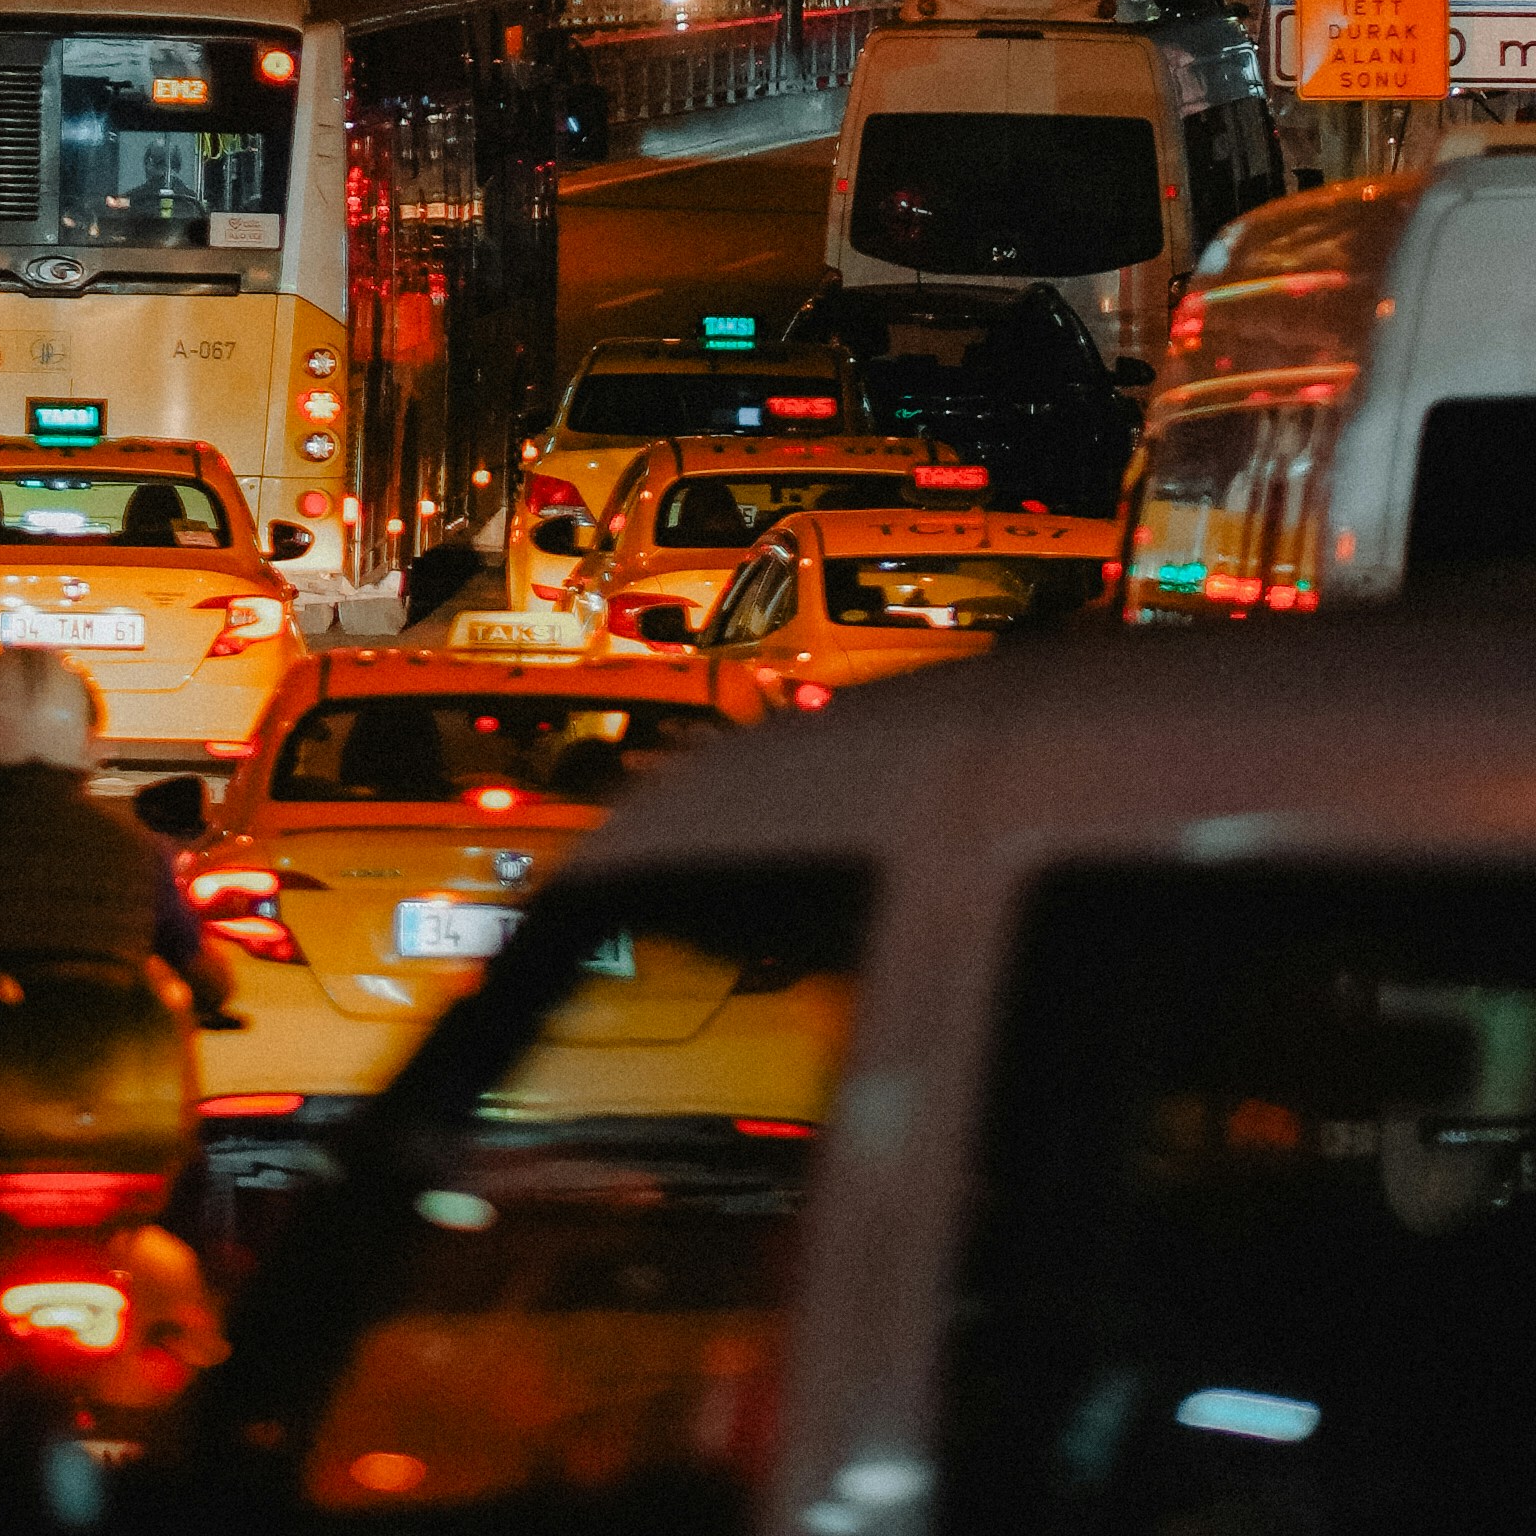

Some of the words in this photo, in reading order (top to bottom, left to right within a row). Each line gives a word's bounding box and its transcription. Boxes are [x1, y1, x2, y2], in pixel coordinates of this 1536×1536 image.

[1328, 23, 1418, 40] DURAK
[1331, 47, 1417, 64] ALANI
[1340, 71, 1407, 89] SONU
[172, 339, 237, 361] A-067
[59, 618, 94, 640] TAM
[115, 621, 136, 641] 61
[474, 625, 562, 642] TAKSI
[425, 914, 461, 948] 34
